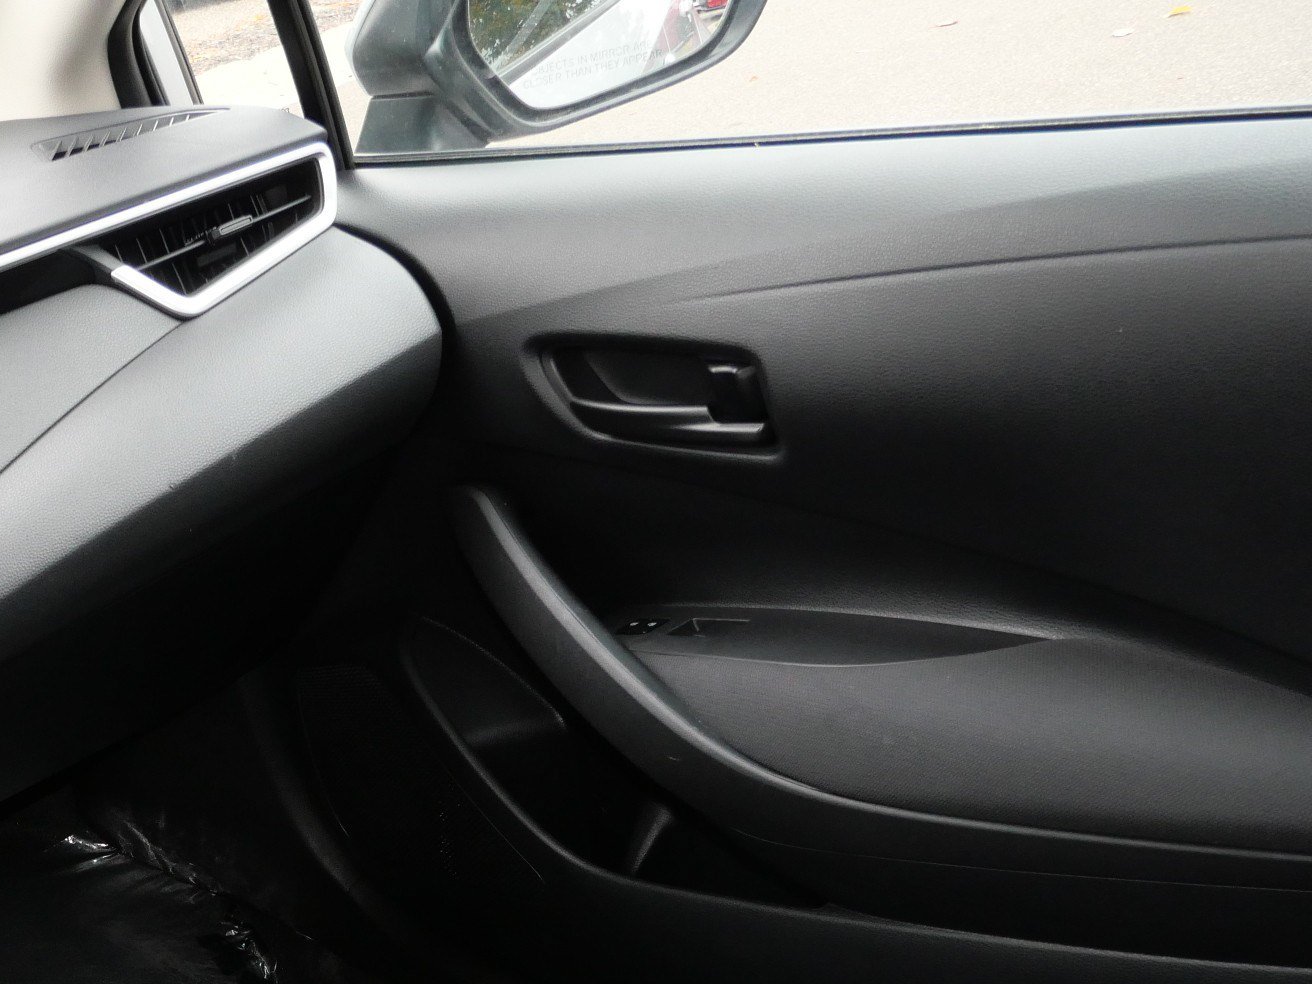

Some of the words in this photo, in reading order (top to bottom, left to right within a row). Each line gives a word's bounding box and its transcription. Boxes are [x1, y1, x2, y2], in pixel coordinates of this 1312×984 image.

[566, 66, 592, 80] THAN
[595, 58, 620, 72] THEY
[622, 48, 663, 66] APPEAR
[590, 44, 631, 63] MIRROR
